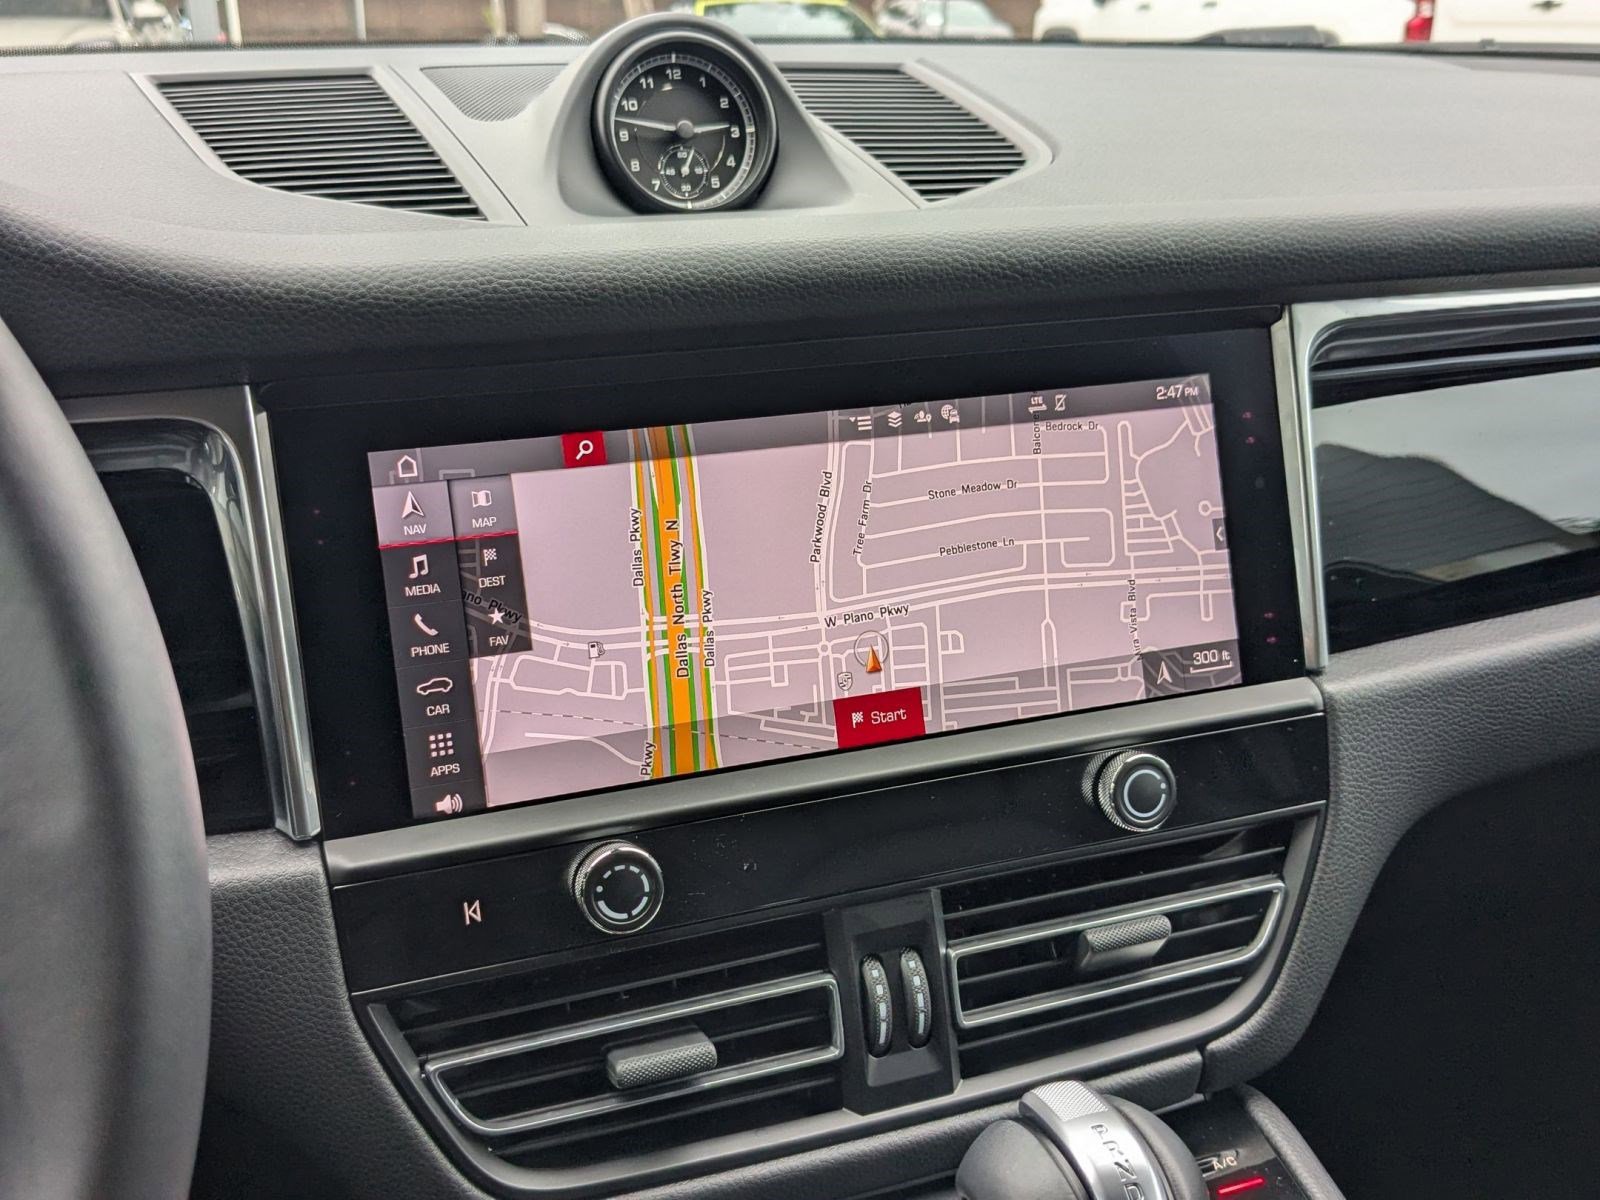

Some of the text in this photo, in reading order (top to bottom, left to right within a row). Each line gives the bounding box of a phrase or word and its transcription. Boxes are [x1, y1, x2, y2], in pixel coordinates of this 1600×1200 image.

[666, 69, 681, 80] 12
[640, 77, 654, 89] 11
[699, 77, 706, 87] 1
[621, 99, 638, 111] 10
[720, 97, 729, 109] 2
[619, 129, 629, 141] 9
[731, 126, 740, 138] 3
[631, 159, 640, 171] 8
[726, 155, 736, 167] 4
[652, 179, 660, 191] 7
[711, 176, 720, 188] 5
[1156, 385, 1198, 400] 2:47 PM
[1046, 421, 1099, 431] Bedrock Dr
[928, 479, 1018, 500] Stone Meadow Dr
[472, 516, 497, 528] MAP
[810, 471, 832, 563] Parkwood Blvd
[853, 480, 872, 556] Tree Farm Dr
[404, 524, 427, 536] NAV
[630, 508, 643, 586] Dallas Pkwy
[939, 538, 1015, 556] Pebblestone Ln
[479, 575, 506, 588] DEST
[405, 583, 441, 597] MEDIA
[1128, 579, 1136, 601] Blvd
[666, 520, 689, 677] Dallas North Tlwy N
[825, 604, 910, 627] W Plano Pkwy
[702, 590, 715, 666] Dallas Pkwy
[489, 635, 509, 647] FAV
[411, 643, 450, 657] PHONE
[1193, 650, 1231, 665] 300 ft
[426, 704, 450, 717] CAR
[871, 709, 906, 724] Start
[641, 742, 656, 776] Pkwy
[430, 763, 460, 777] APPS
[1213, 1156, 1237, 1171] A/C
